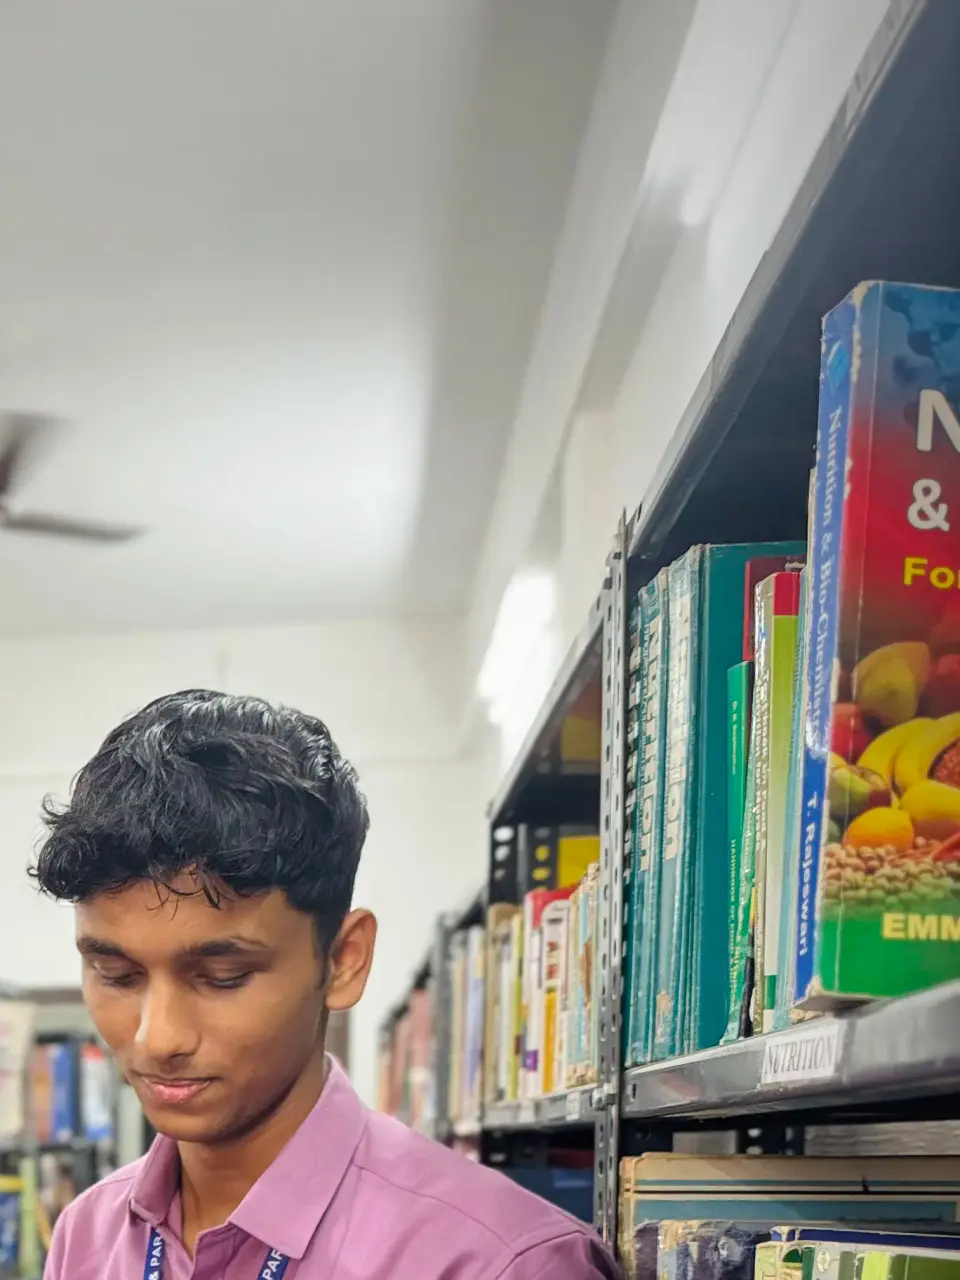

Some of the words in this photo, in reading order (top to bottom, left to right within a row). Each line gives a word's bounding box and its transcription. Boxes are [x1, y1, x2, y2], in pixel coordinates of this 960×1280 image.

[821, 406, 843, 527] Nutrition
[908, 478, 949, 531] &
[820, 533, 834, 551] &
[903, 557, 960, 590] Fo
[808, 791, 818, 817] T.
[799, 822, 816, 956] Rajeswari
[764, 1036, 836, 1075] NUTRITION
